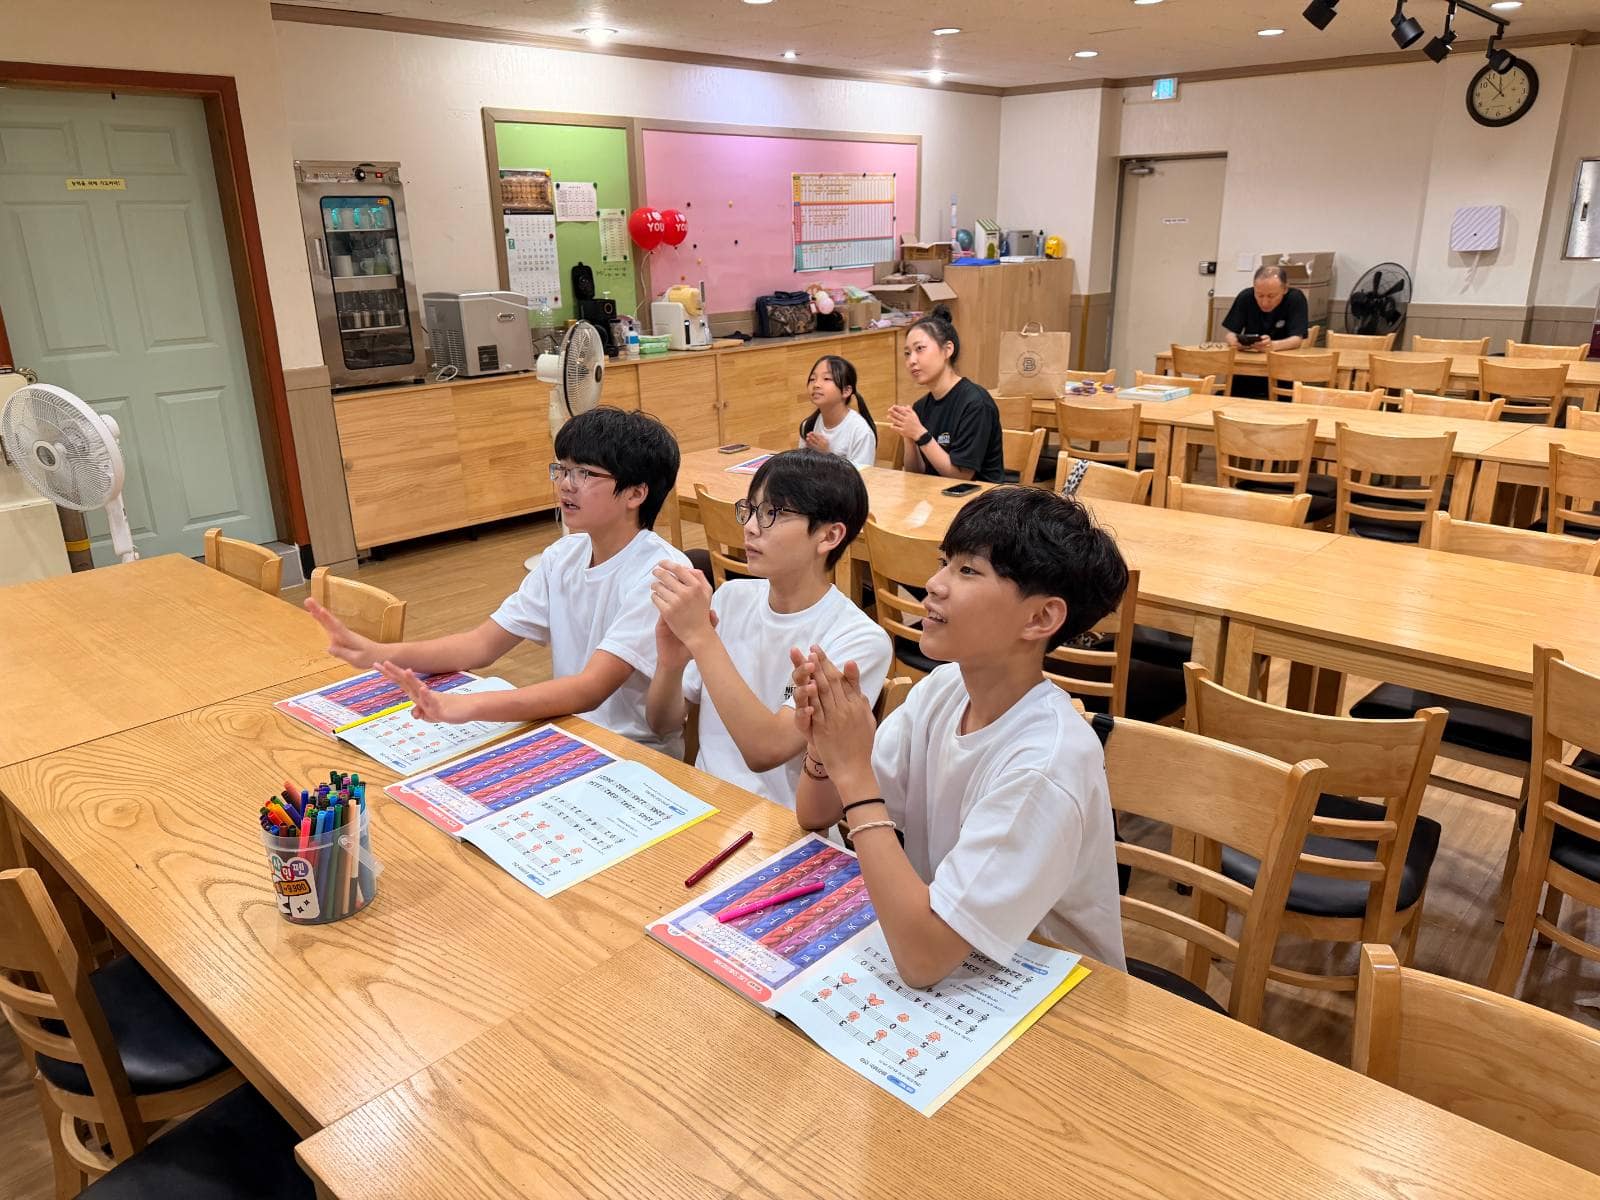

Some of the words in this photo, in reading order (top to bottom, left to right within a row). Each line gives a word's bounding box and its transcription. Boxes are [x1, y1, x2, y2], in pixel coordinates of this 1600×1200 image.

[647, 222, 664, 232] YOU
[1023, 357, 1036, 371] B
[961, 960, 983, 974] 234
[988, 974, 1011, 988] 1545
